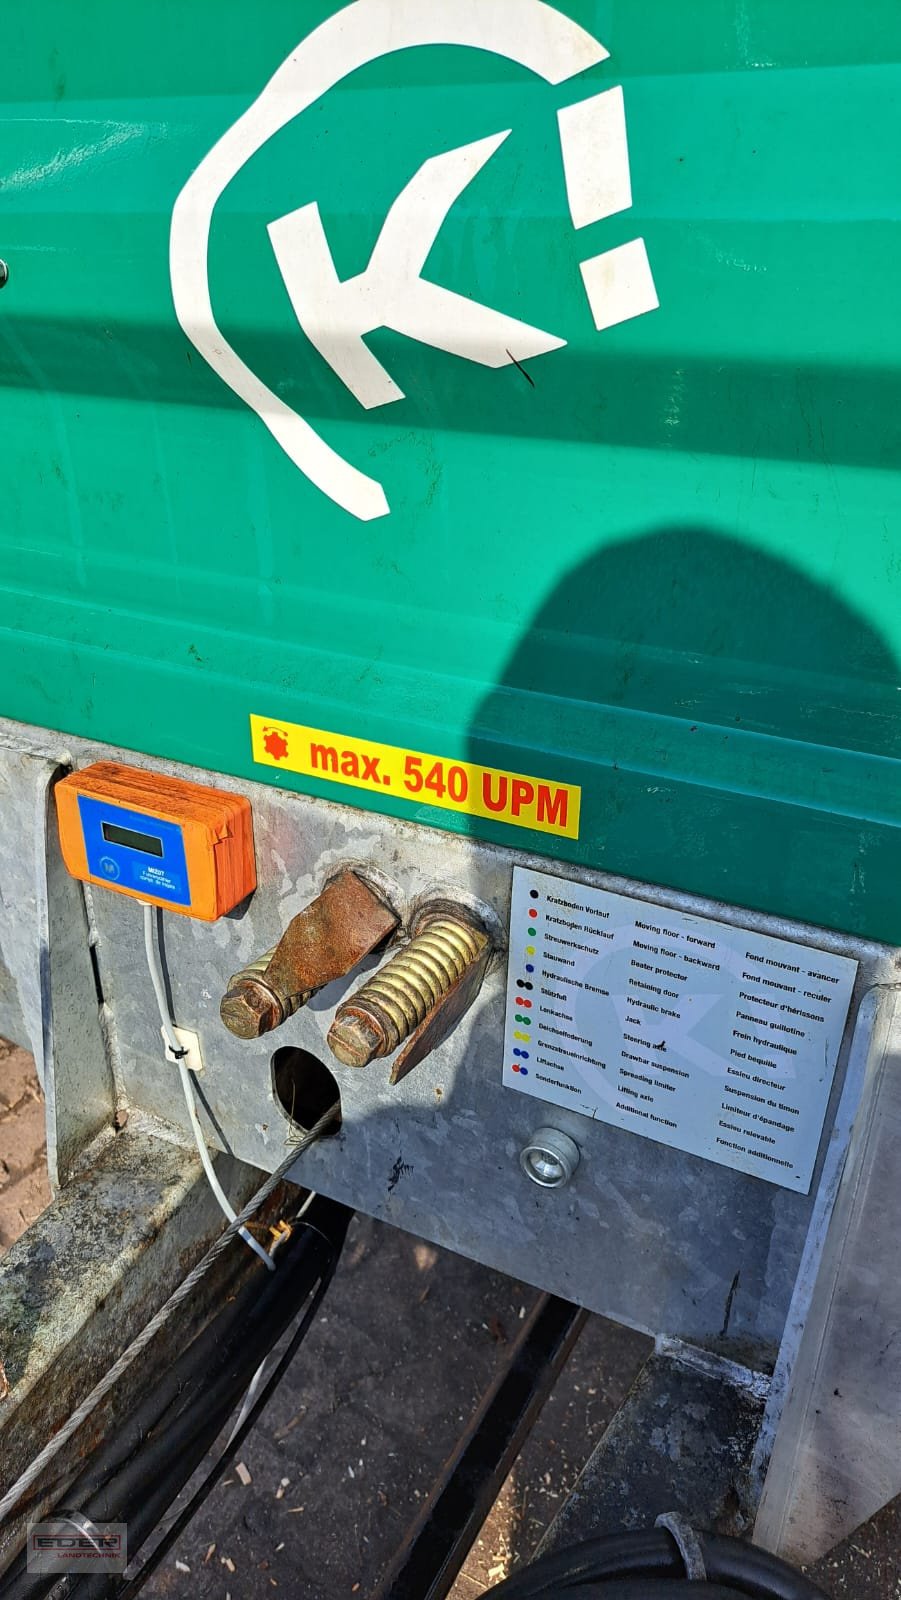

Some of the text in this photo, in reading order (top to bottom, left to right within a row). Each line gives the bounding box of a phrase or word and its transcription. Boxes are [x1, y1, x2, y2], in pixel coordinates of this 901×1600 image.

[310, 742, 569, 828] max. 540 UPM
[547, 895, 609, 918] Kratzboden Vorlauf
[545, 933, 599, 954] Streuwerkschutz
[584, 926, 614, 940] Rücklauf
[635, 921, 660, 934] Moving
[663, 929, 679, 938] floor
[687, 935, 715, 948] forward
[543, 952, 575, 966] Stauwand
[633, 940, 658, 954] Moving
[661, 948, 677, 958] floor
[684, 955, 720, 970] backward
[631, 960, 688, 981] Beater protector
[746, 952, 764, 963] Fond
[766, 959, 800, 973] mouvant
[808, 971, 839, 984] avancer
[585, 984, 609, 996] Bremse
[629, 978, 679, 998] Retaining door
[742, 972, 760, 982] Fond
[762, 979, 796, 993] mouvant
[804, 991, 832, 1003] reculer
[627, 997, 680, 1018] Hydraulic brake
[739, 992, 779, 1008] Protecteur
[540, 1005, 572, 1021] Lenkachse
[625, 1016, 641, 1025] Jack
[736, 1011, 805, 1037] Panneau guillotine
[624, 1033, 650, 1048] Steering
[733, 1030, 797, 1055] Frein hydraulique
[730, 1049, 746, 1058] Pied
[621, 1051, 689, 1078] Drawbar suspension
[536, 1073, 581, 1094] Sonderfunktion
[620, 1068, 676, 1091] Spreading limiter
[727, 1067, 786, 1090] Essieu directeur
[618, 1085, 638, 1098] Lifting
[724, 1085, 765, 1103] Suspension
[779, 1104, 799, 1114] timon
[616, 1102, 677, 1128] Additional function
[722, 1103, 751, 1117] Limiteur
[719, 1120, 741, 1132] Essieu
[716, 1137, 745, 1153] Fonction
